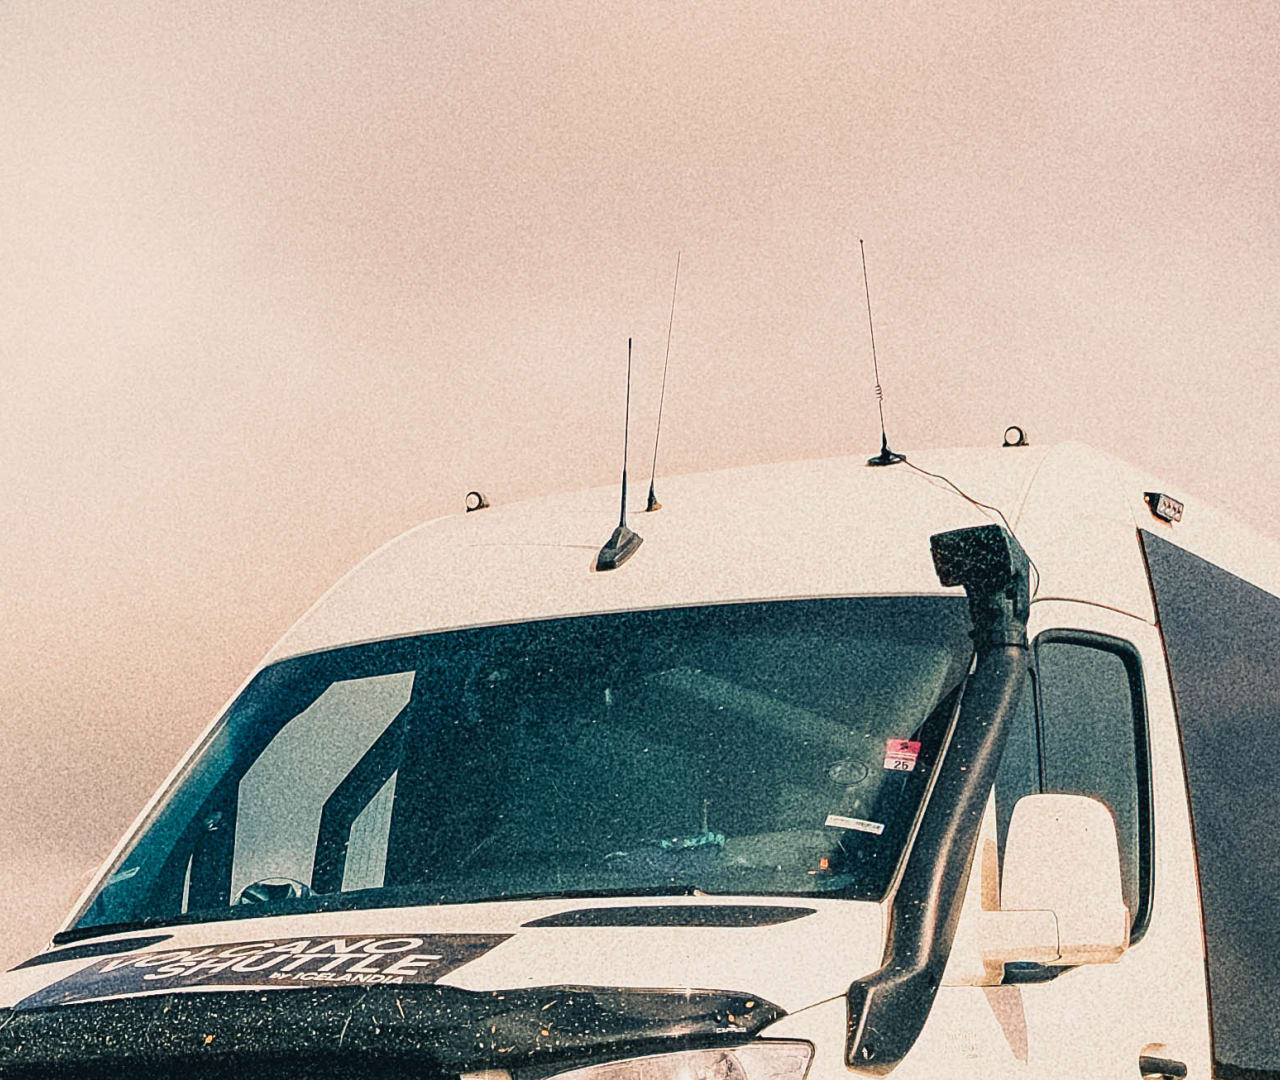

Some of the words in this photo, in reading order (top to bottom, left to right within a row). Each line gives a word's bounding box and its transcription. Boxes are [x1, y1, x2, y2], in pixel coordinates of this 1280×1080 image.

[97, 937, 424, 974] VOLCANO
[143, 953, 443, 980] SHUTTLE
[292, 972, 404, 984] ICELANDIA
